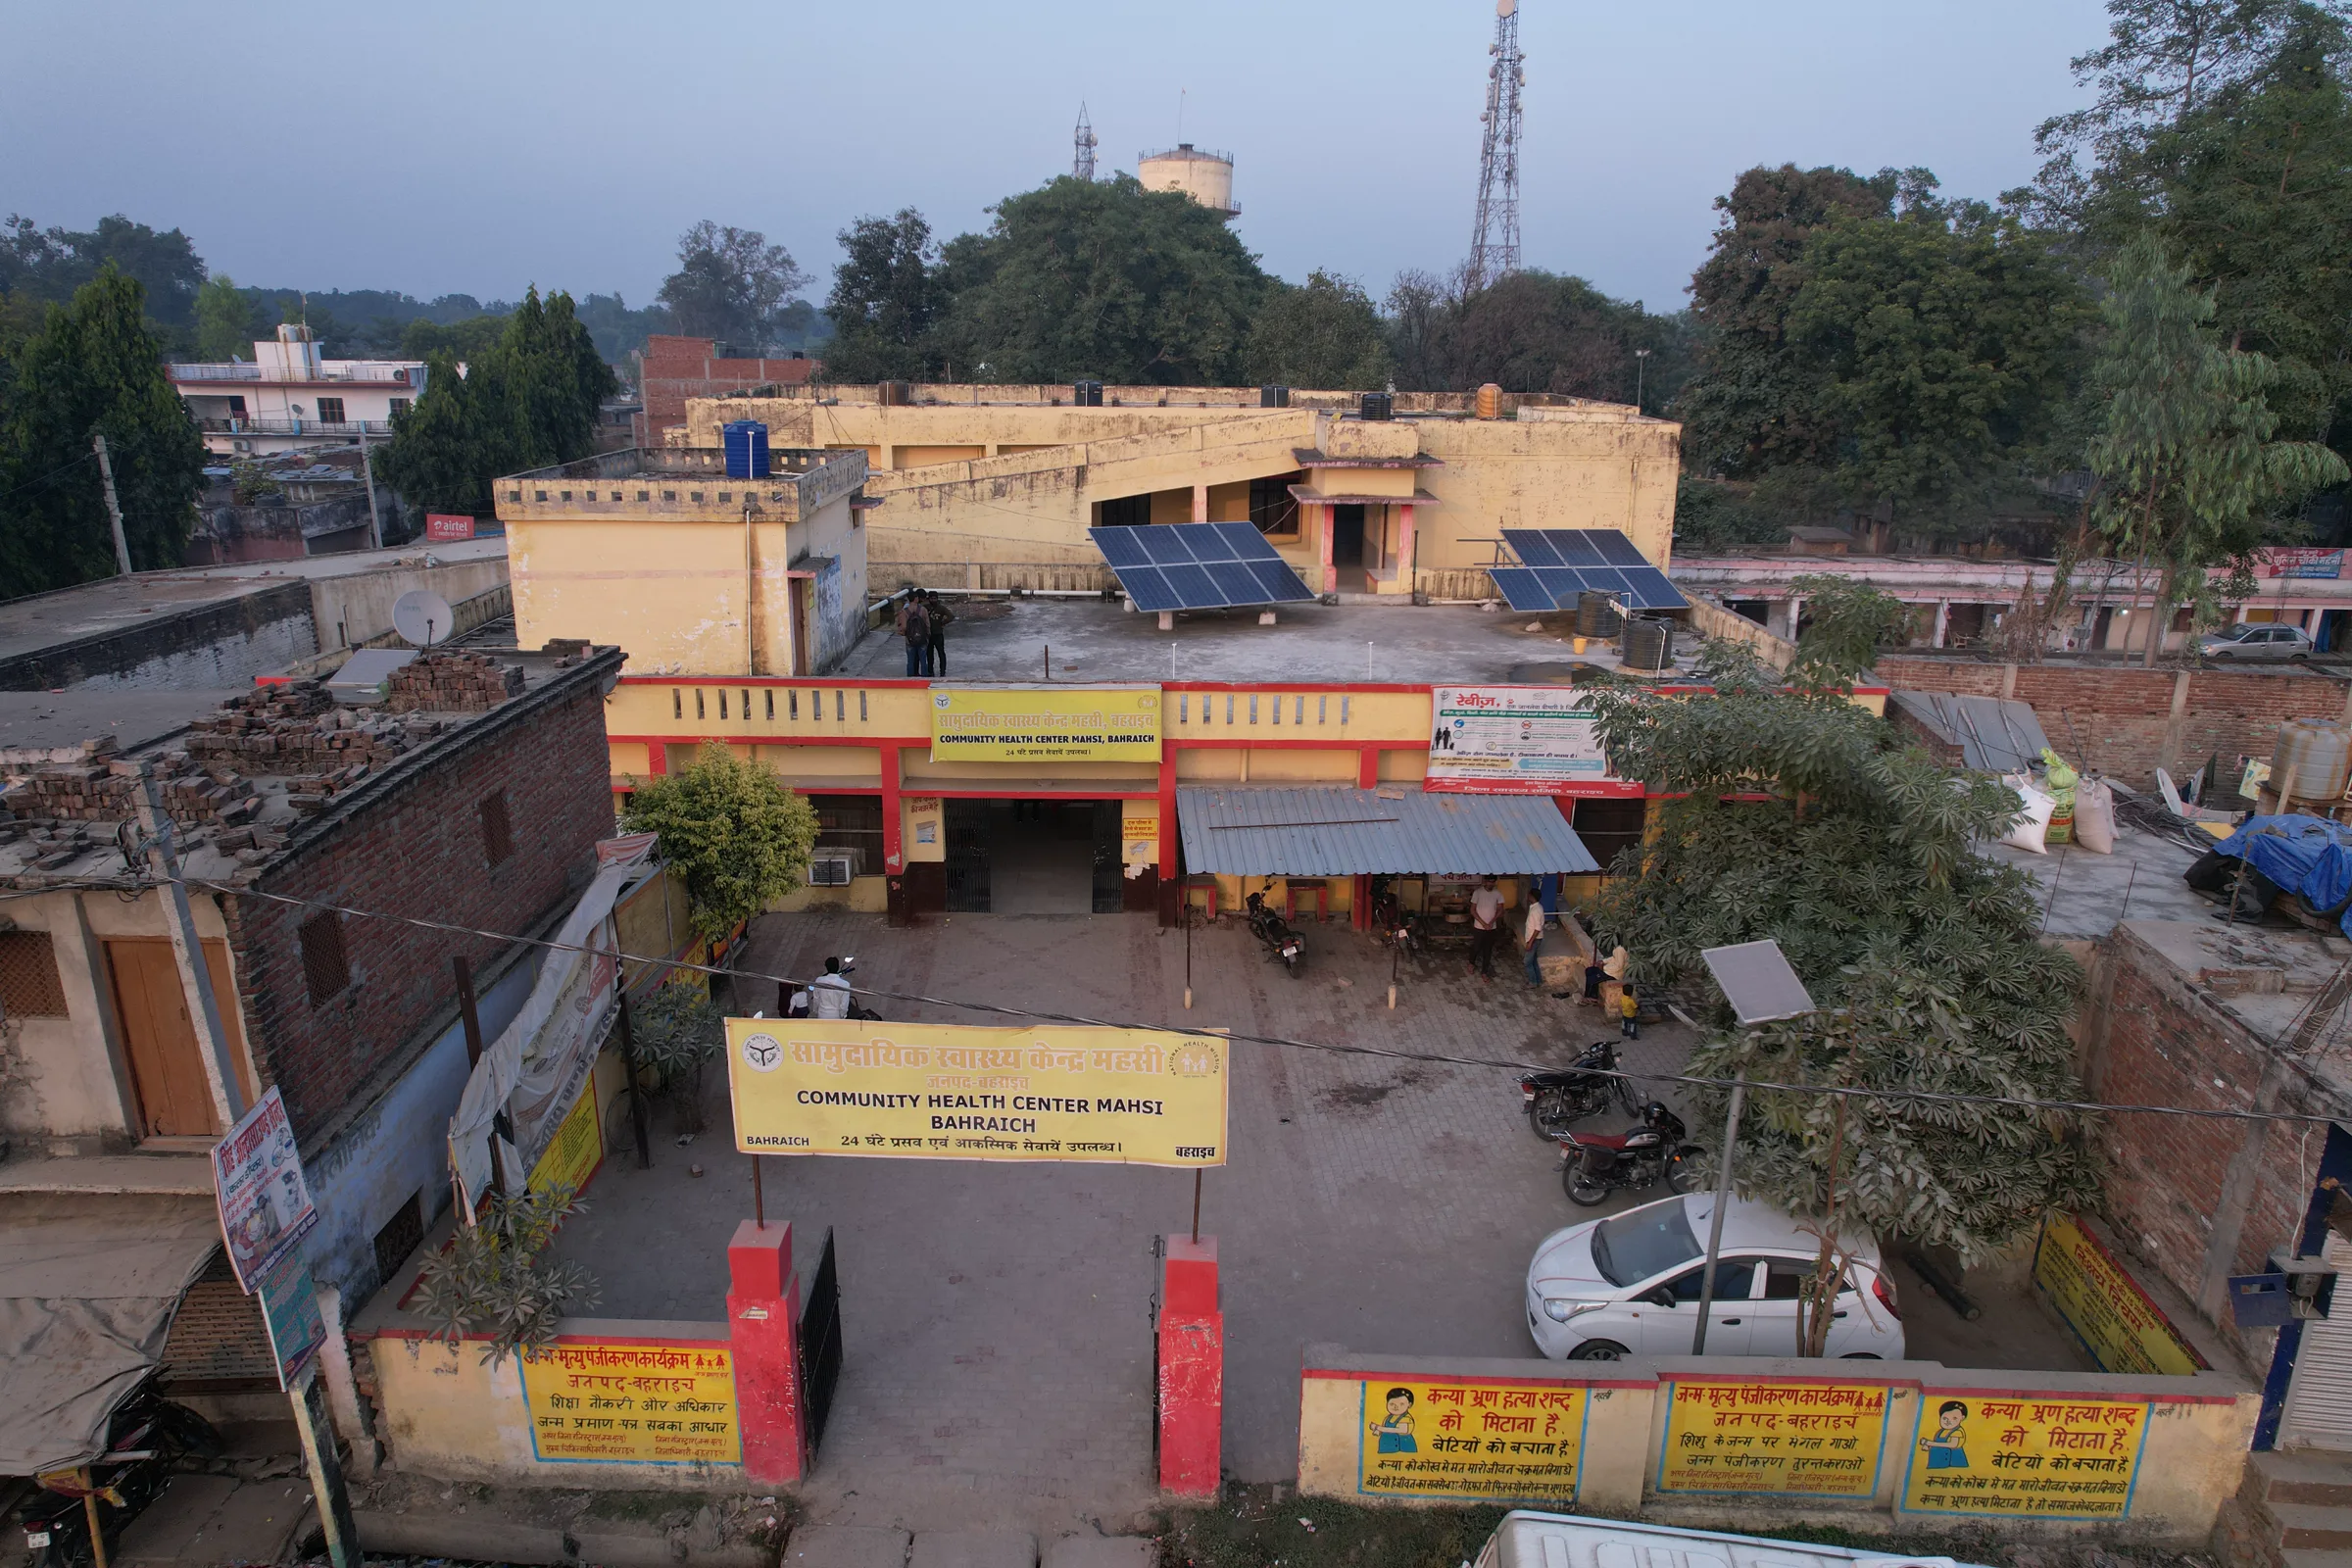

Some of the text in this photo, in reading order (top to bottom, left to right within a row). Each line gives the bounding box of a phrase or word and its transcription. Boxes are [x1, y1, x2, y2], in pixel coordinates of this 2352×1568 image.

[443, 520, 467, 531] airtel
[2274, 554, 2297, 565] पुलिस
[938, 710, 1000, 732] सामुदायिक
[1003, 712, 1041, 729] स्वास्थ्य
[1043, 710, 1069, 729] केन्द्र
[1110, 713, 1155, 729] बहराइच
[940, 734, 1154, 745] COMMUNITY HEALTH CENTER MAHSI, BAHRAICH
[788, 1037, 930, 1074] सामुदायिक
[934, 1046, 1024, 1070] स्वास्थ्य
[1028, 1040, 1088, 1074] केन्द्र
[1091, 1042, 1167, 1074] महसी
[1168, 1047, 1182, 1076] NATIONAL
[1209, 1048, 1219, 1075] MISSION
[926, 1074, 1030, 1092] जनपद-बहराइच
[797, 1090, 1163, 1115] COMMUNITY HEALTH CENTER MAHSI
[931, 1115, 1036, 1133] BAHRAICH
[747, 1136, 809, 1147] BAHRAICH
[841, 1135, 858, 1147] 24
[865, 1133, 885, 1147] घंटे
[890, 1137, 922, 1149] प्रसव
[928, 1135, 949, 1151] एवं
[956, 1136, 1017, 1151] आकस्मिक
[1023, 1139, 1061, 1152] सेवायें
[1175, 1147, 1215, 1158] बहराइच
[2109, 1284, 2144, 1333] दिवस
[550, 1394, 728, 1413] शिक्षा नौकरी और अधिकार
[1427, 1388, 1467, 1407] कन्या
[1503, 1390, 1536, 1409] हत्या
[1740, 1384, 1801, 1406] पंजीकरण
[1799, 1386, 1856, 1407] कार्यक्रम
[537, 1416, 728, 1434] जन्म सबका आधार
[1439, 1409, 1538, 1434] को मिटाना
[2064, 1405, 2103, 1425] हत्या
[2103, 1406, 2140, 1427] शब्द
[1432, 1435, 1481, 1453] बेटियों
[1486, 1437, 1506, 1454] को
[1510, 1440, 1556, 1456] बचाना
[1680, 1432, 1824, 1450] शिशु के जन्म पर मंगल
[2000, 1425, 2031, 1446] को
[2048, 1427, 2107, 1450] मिटाना
[1378, 1460, 1403, 1472] कन्या
[1405, 1458, 1417, 1471] को
[1417, 1458, 1441, 1472] कोख
[1450, 1462, 1465, 1472] मत
[1468, 1460, 1487, 1474] मारो
[1486, 1461, 1515, 1475] जीवन
[1531, 1464, 1544, 1476] मत
[1687, 1452, 1824, 1471] जन्म पंजीकरण तुरन्त
[2050, 1452, 2129, 1472] को बचाना है
[1925, 1476, 1950, 1488] कन्या
[1949, 1475, 1964, 1488] को
[1962, 1475, 1988, 1490] कोख
[2001, 1479, 2017, 1490] मत
[2019, 1476, 2040, 1492] मारो
[1920, 1494, 1946, 1507] कन्या
[1989, 1494, 2023, 1509] मिटाना
[2025, 1495, 2034, 1511] है
[2034, 1497, 2048, 1509] तो
